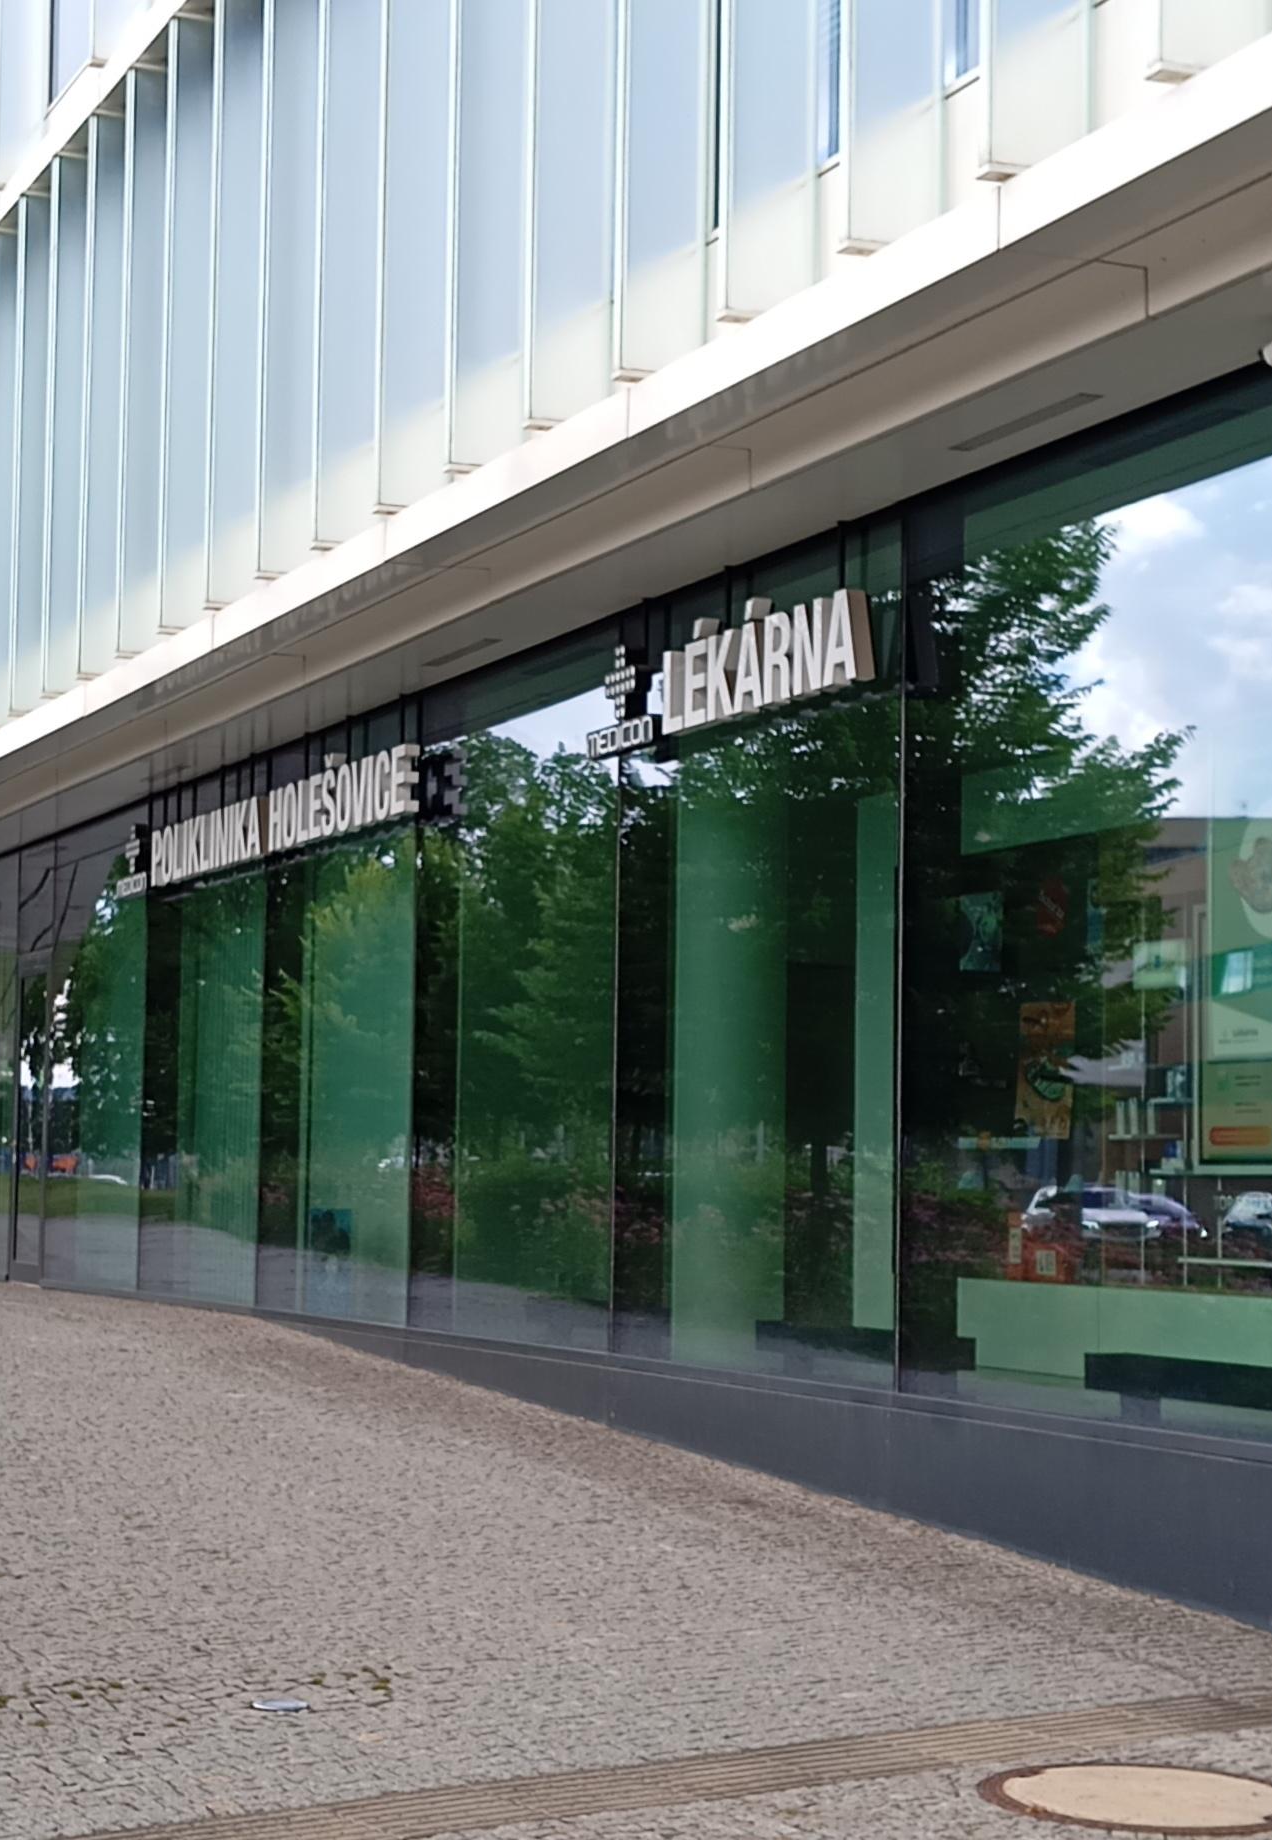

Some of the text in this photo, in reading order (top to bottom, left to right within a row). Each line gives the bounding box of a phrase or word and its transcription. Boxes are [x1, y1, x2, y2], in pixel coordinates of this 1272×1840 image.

[662, 588, 873, 735] LÉKÁRNA
[151, 743, 419, 887] POLIKLINIKA HOLEŠOVICE
